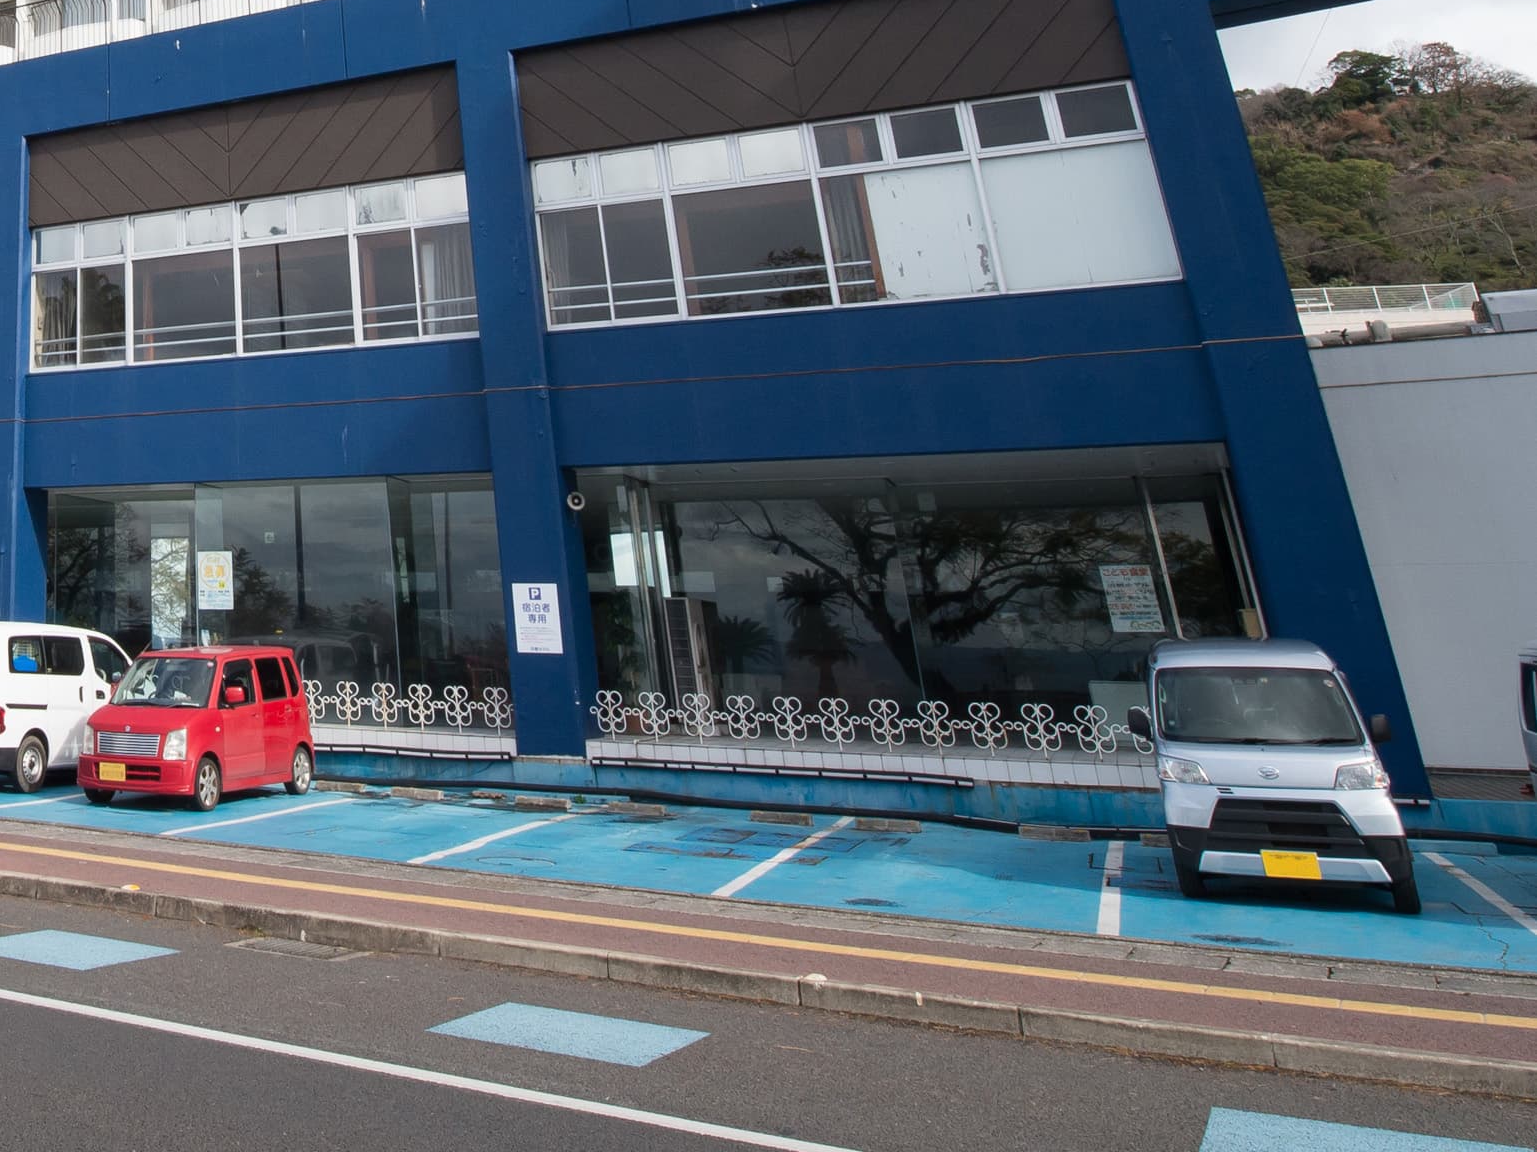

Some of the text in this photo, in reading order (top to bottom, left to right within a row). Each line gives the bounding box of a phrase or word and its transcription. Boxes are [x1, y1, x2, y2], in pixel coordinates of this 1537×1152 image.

[530, 588, 540, 600] P
[522, 603, 550, 613] 宿泊者
[528, 614, 547, 624] 専用
